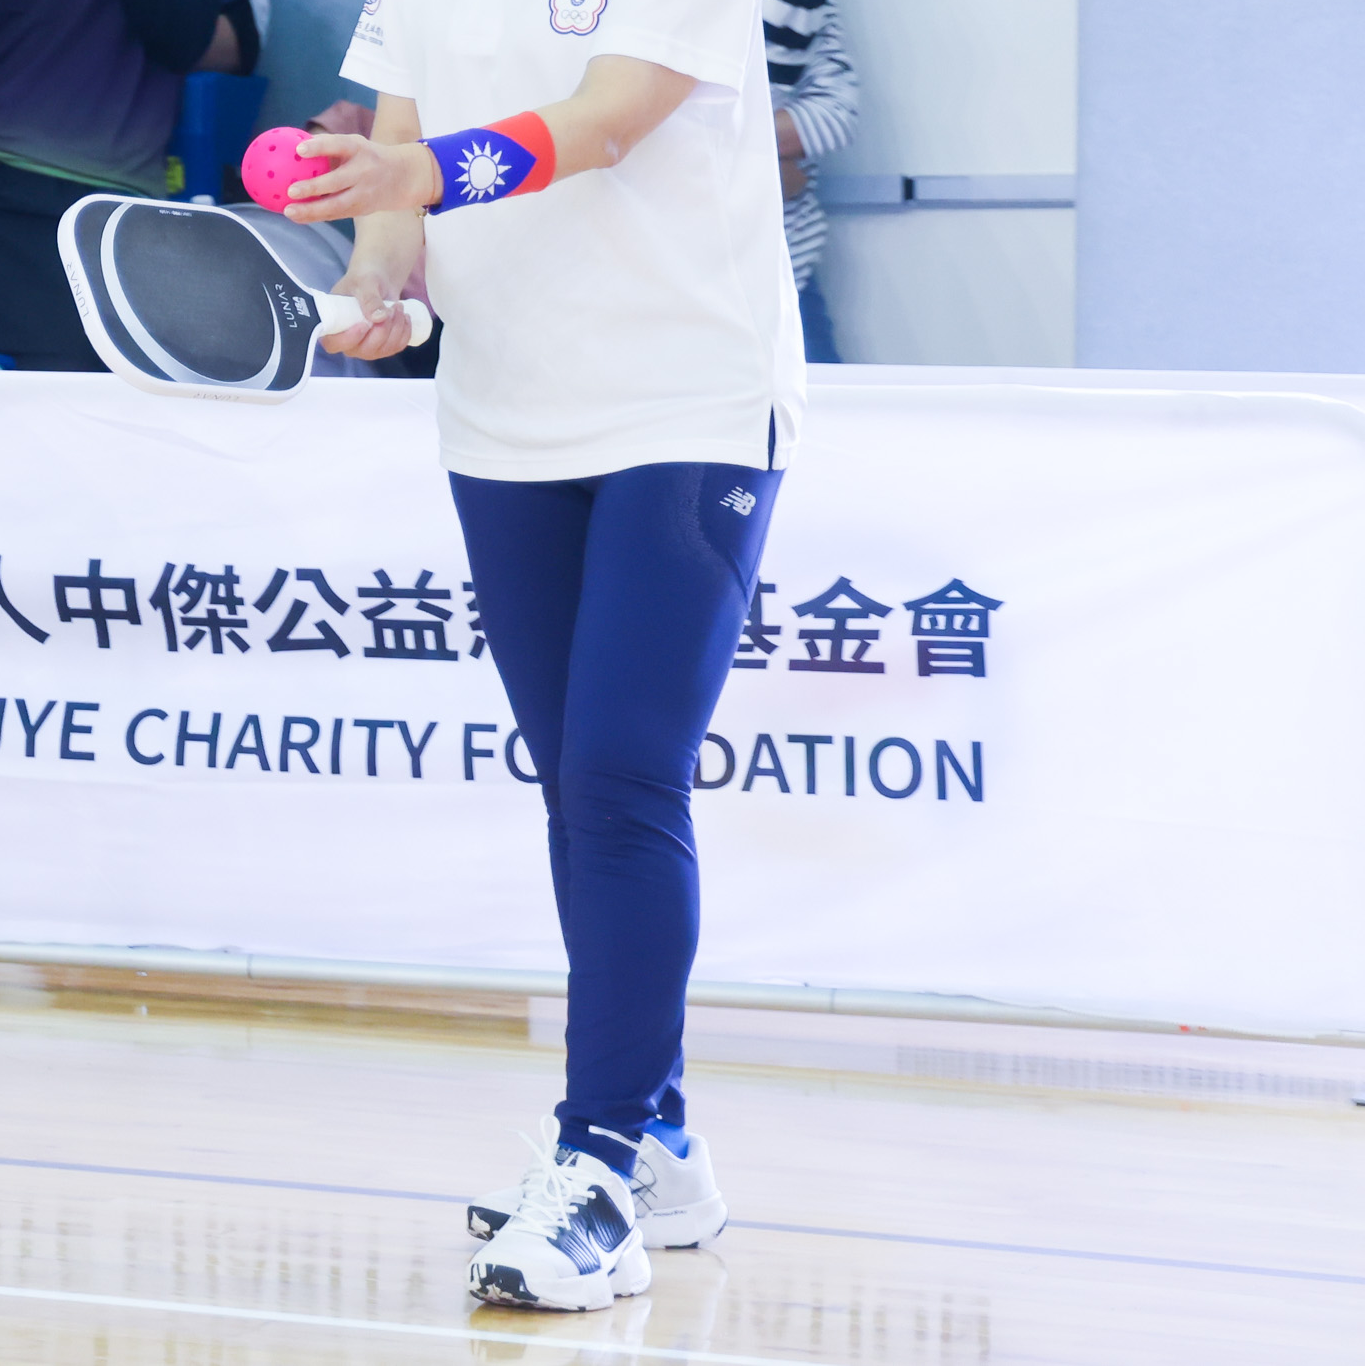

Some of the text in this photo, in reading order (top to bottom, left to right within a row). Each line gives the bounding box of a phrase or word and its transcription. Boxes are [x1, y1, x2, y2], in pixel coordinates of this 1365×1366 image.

[275, 283, 298, 328] LUNAR
[125, 708, 438, 779] CHARITY
[463, 721, 985, 803] FODATION
